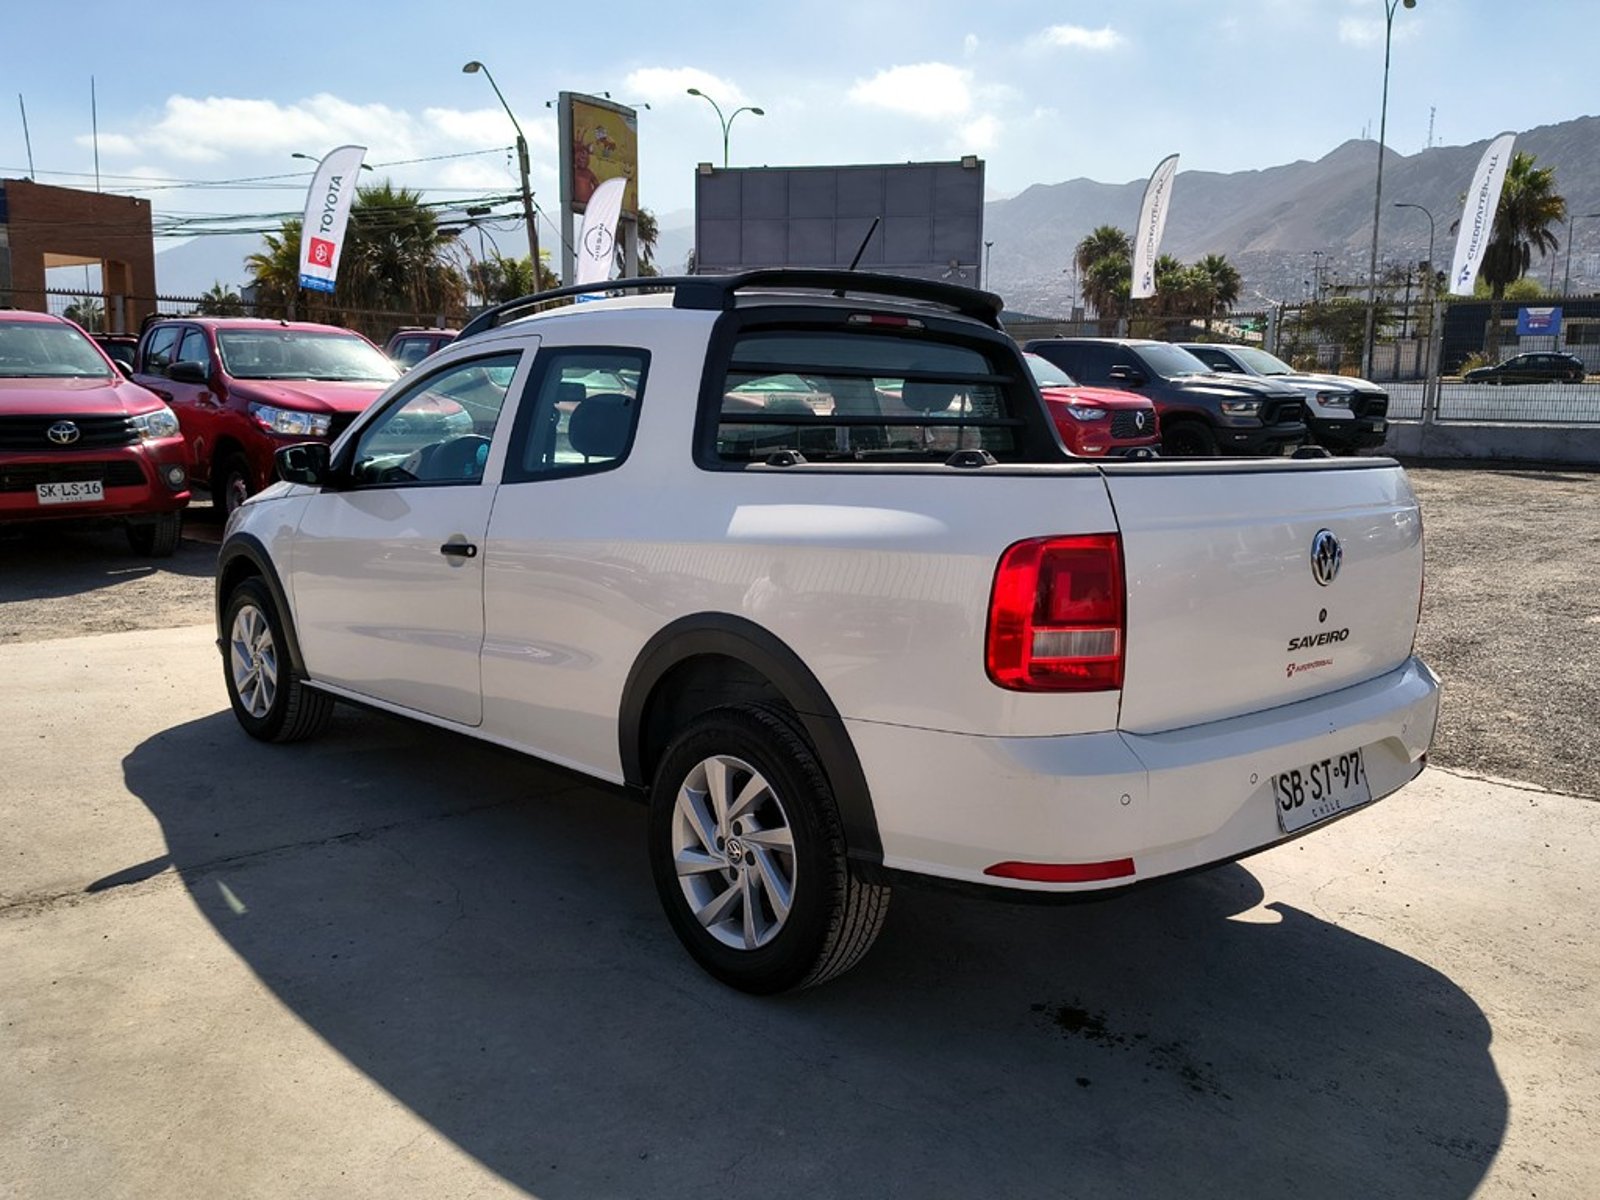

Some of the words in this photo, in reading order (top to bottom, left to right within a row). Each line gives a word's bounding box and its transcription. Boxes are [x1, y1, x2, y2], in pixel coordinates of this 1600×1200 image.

[320, 175, 343, 234] TOYOTA
[594, 223, 604, 261] NISSAN
[1287, 628, 1350, 651] SAVEIRO
[1311, 799, 1342, 818] CHILE
